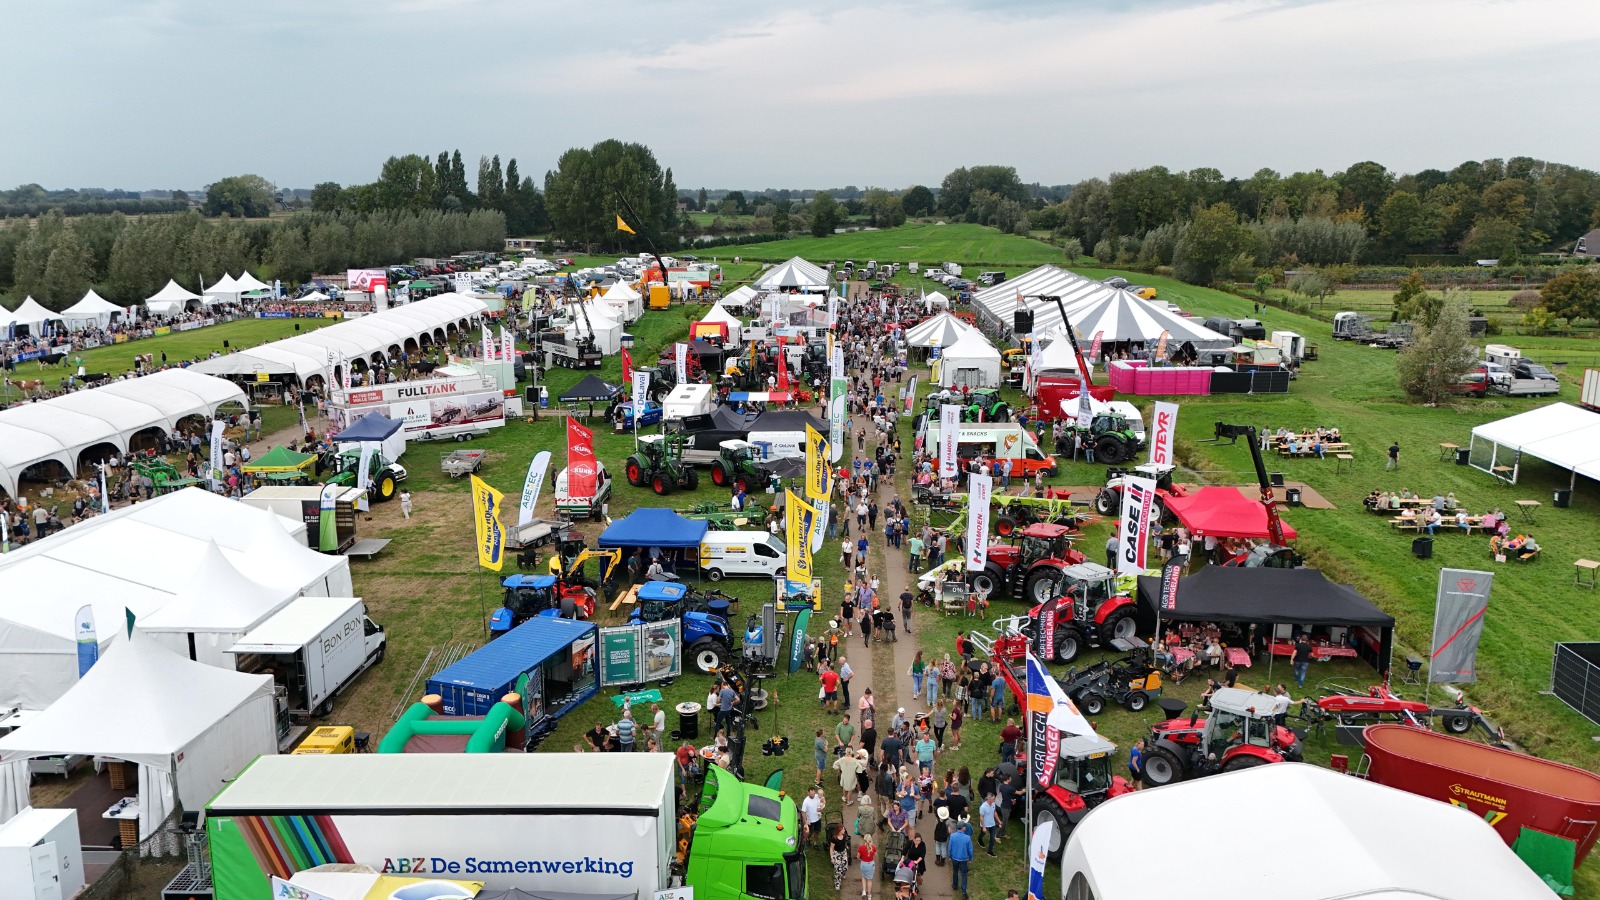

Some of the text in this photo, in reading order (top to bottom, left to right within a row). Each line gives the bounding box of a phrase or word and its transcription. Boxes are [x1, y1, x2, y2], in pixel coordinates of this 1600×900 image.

[398, 383, 456, 397] FULLTANK
[574, 446, 592, 454] KUHN
[1155, 411, 1170, 464] STEYR
[797, 506, 806, 540] HOLLAND
[1140, 491, 1150, 534] AGRICULTURE
[1126, 506, 1141, 563] CASE
[1164, 565, 1173, 593] TECHNIEK
[1169, 566, 1181, 610] SLINGELAND
[324, 631, 342, 654] BON
[344, 615, 361, 636] BON
[1036, 750, 1045, 780] AGRI
[1454, 786, 1507, 805] STRAUTMANN
[381, 857, 633, 878] ABZ De Samenwerking
